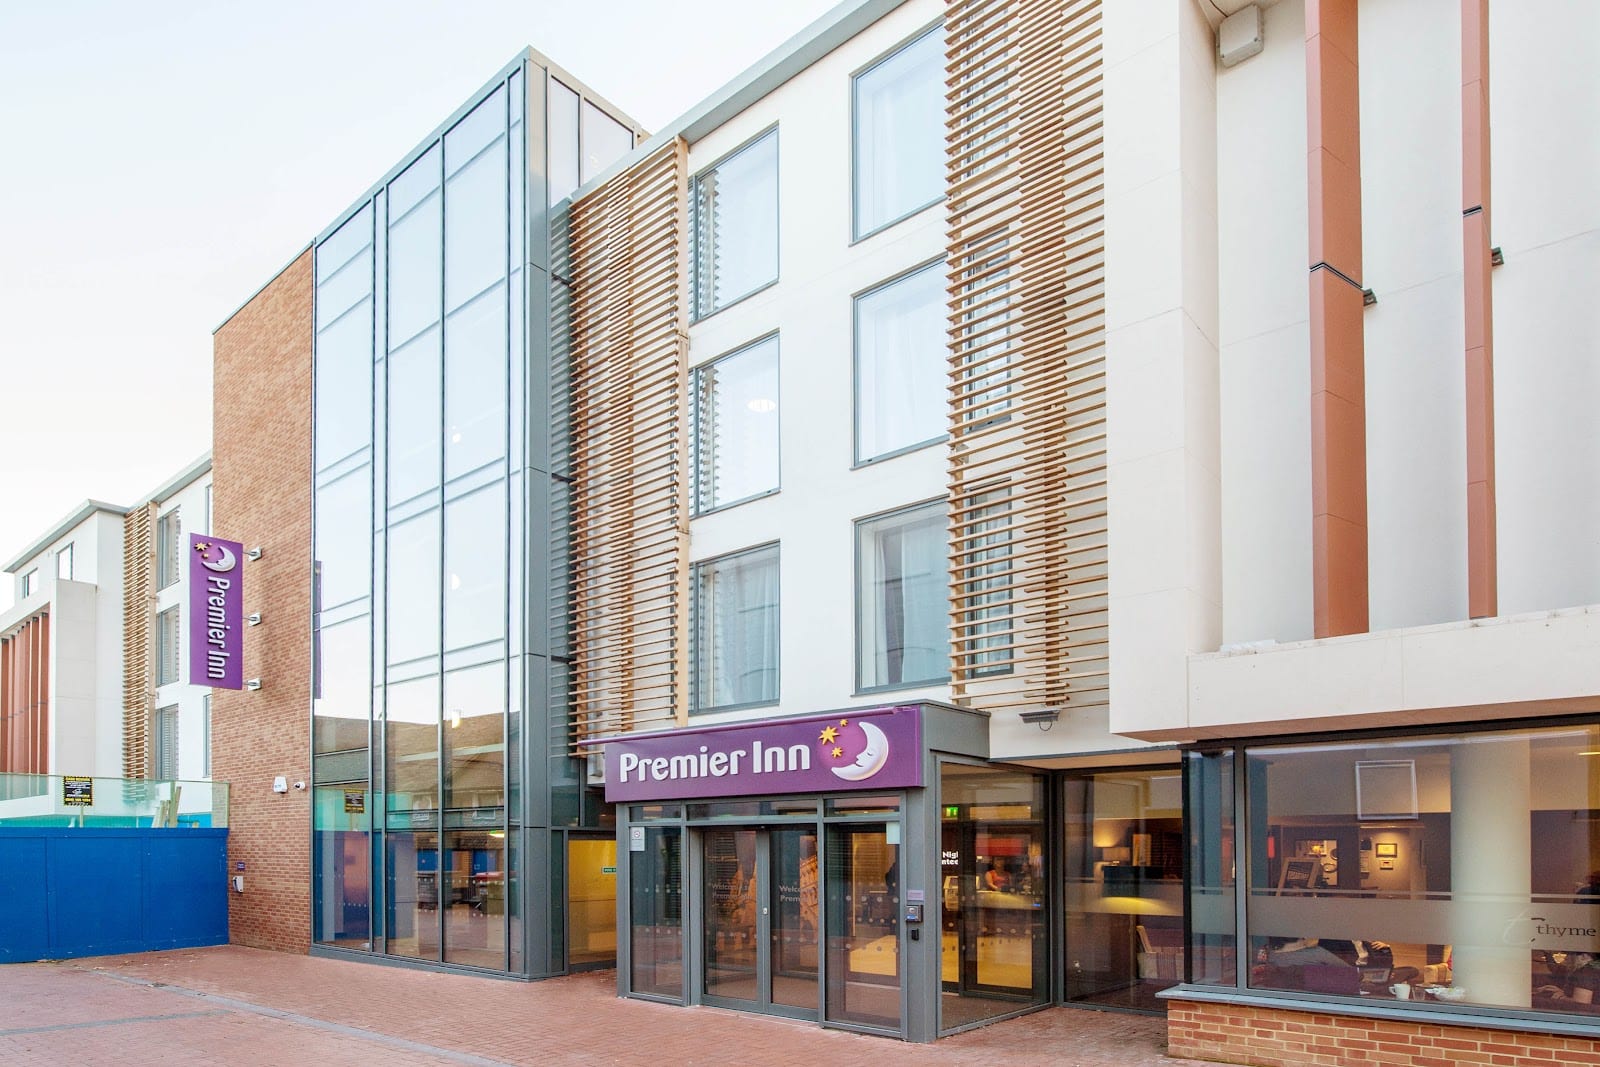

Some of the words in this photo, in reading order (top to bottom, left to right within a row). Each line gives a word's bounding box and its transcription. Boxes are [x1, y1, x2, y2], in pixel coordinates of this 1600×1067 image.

[207, 576, 230, 649] Premier
[207, 650, 230, 679] Inn
[619, 745, 747, 783] Premier
[752, 740, 811, 774] Inn
[1535, 923, 1597, 938] thyme
